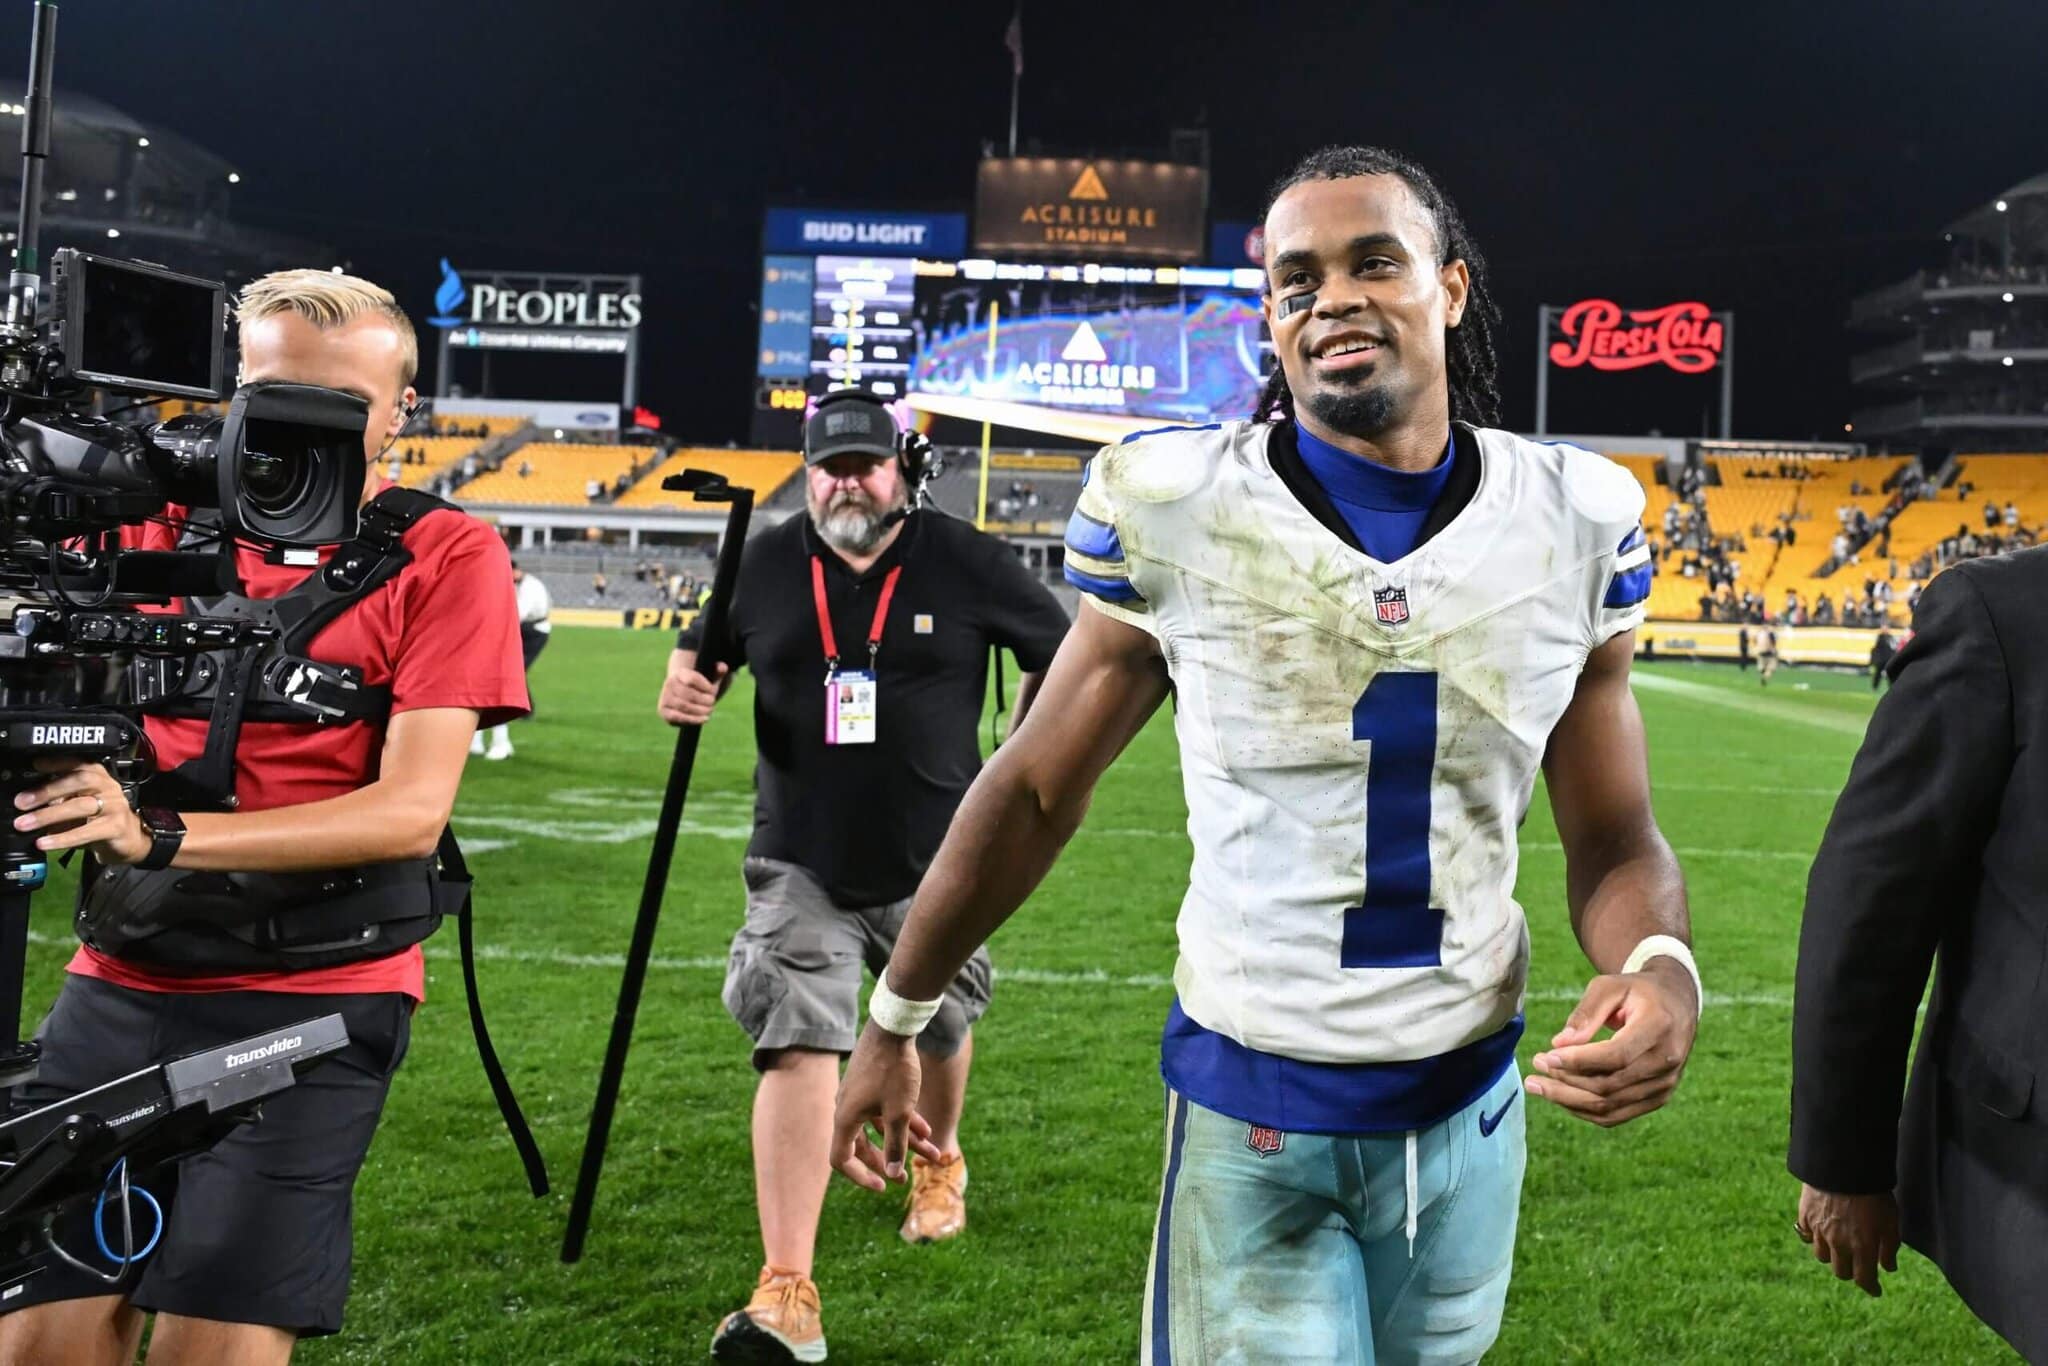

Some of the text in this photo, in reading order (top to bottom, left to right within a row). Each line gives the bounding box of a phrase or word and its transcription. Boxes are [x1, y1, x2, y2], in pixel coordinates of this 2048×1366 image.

[1021, 204, 1157, 227] ACRISURE
[804, 221, 926, 244] BUD LIGHT
[1045, 227, 1127, 243] STADIUM
[471, 285, 641, 328] PEOPLES
[1015, 361, 1155, 389] ACRISURE
[1378, 601, 1407, 621] NFL
[32, 725, 105, 745] BARBER
[1340, 671, 1445, 968] 1
[225, 1036, 302, 1068] transvideo
[1252, 1128, 1279, 1148] NFL
